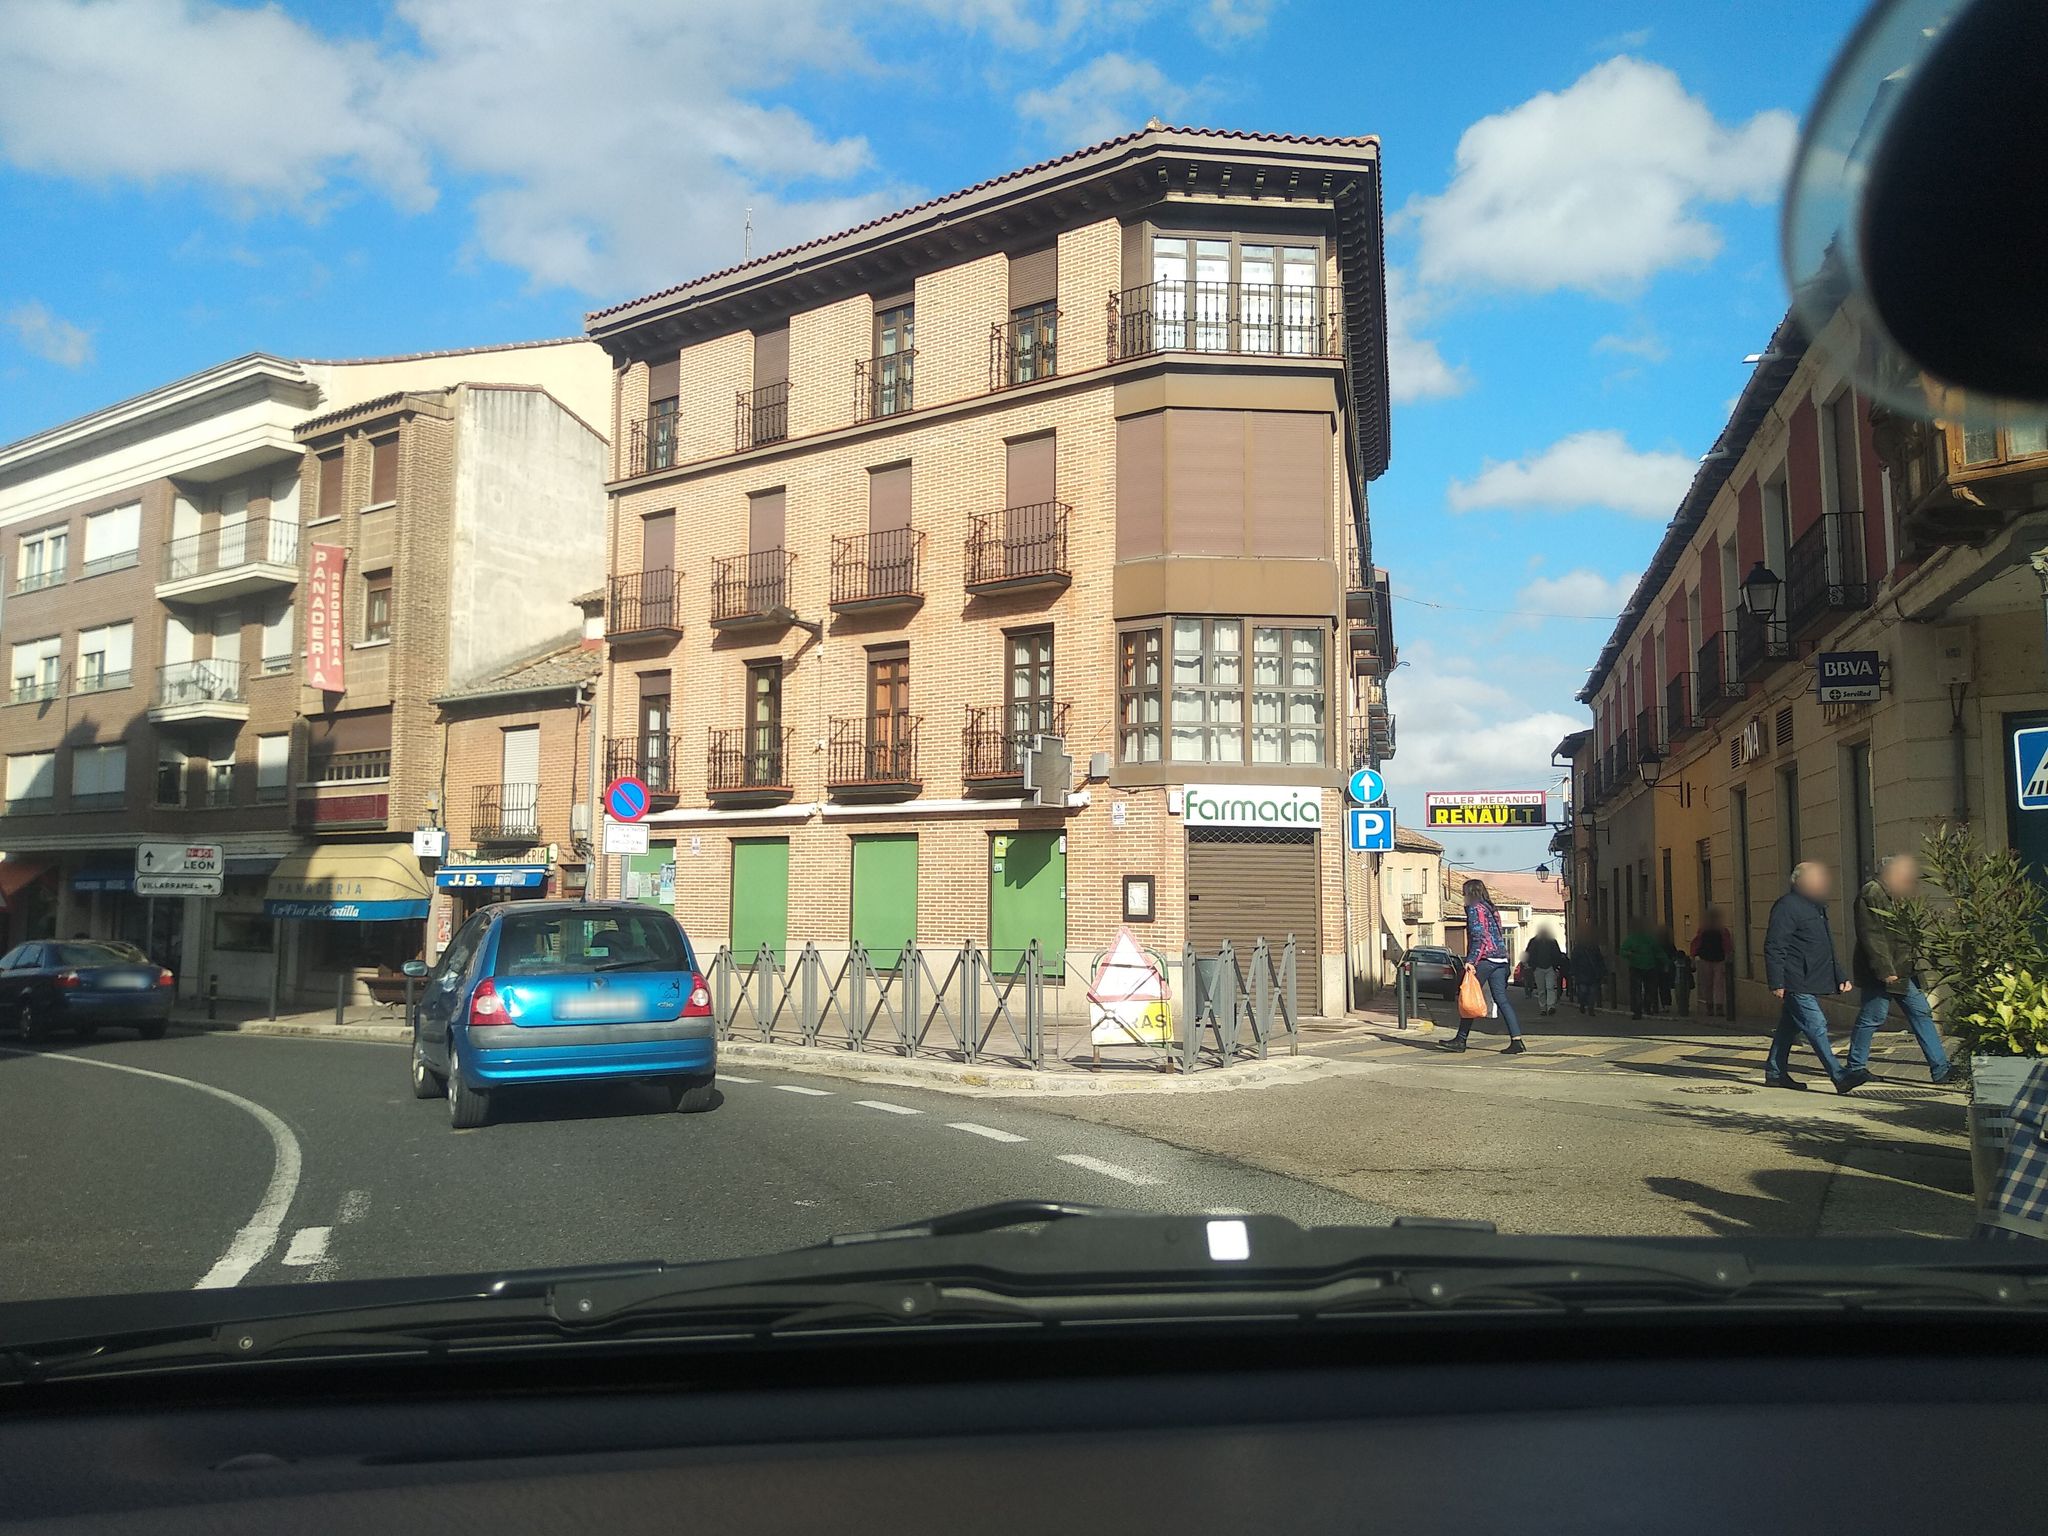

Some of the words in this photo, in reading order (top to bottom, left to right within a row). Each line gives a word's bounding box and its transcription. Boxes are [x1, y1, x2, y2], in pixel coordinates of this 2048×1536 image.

[311, 551, 327, 684] PANADERIA
[330, 572, 342, 666] REPOSTERIA
[1824, 661, 1873, 677] BBVA
[1843, 690, 1872, 698] ServiRed
[1433, 796, 1475, 804] TALLER
[1480, 795, 1539, 804] MECANICO
[1435, 808, 1535, 824] RENAULT
[1358, 813, 1384, 847] P
[142, 881, 200, 890] VILLARRAMIEL
[448, 873, 482, 887] J.B.
[272, 904, 284, 915] La
[285, 904, 308, 916] Flor
[308, 905, 319, 916] de
[320, 904, 359, 918] Castilla
[1099, 1014, 1167, 1030] ORAS
